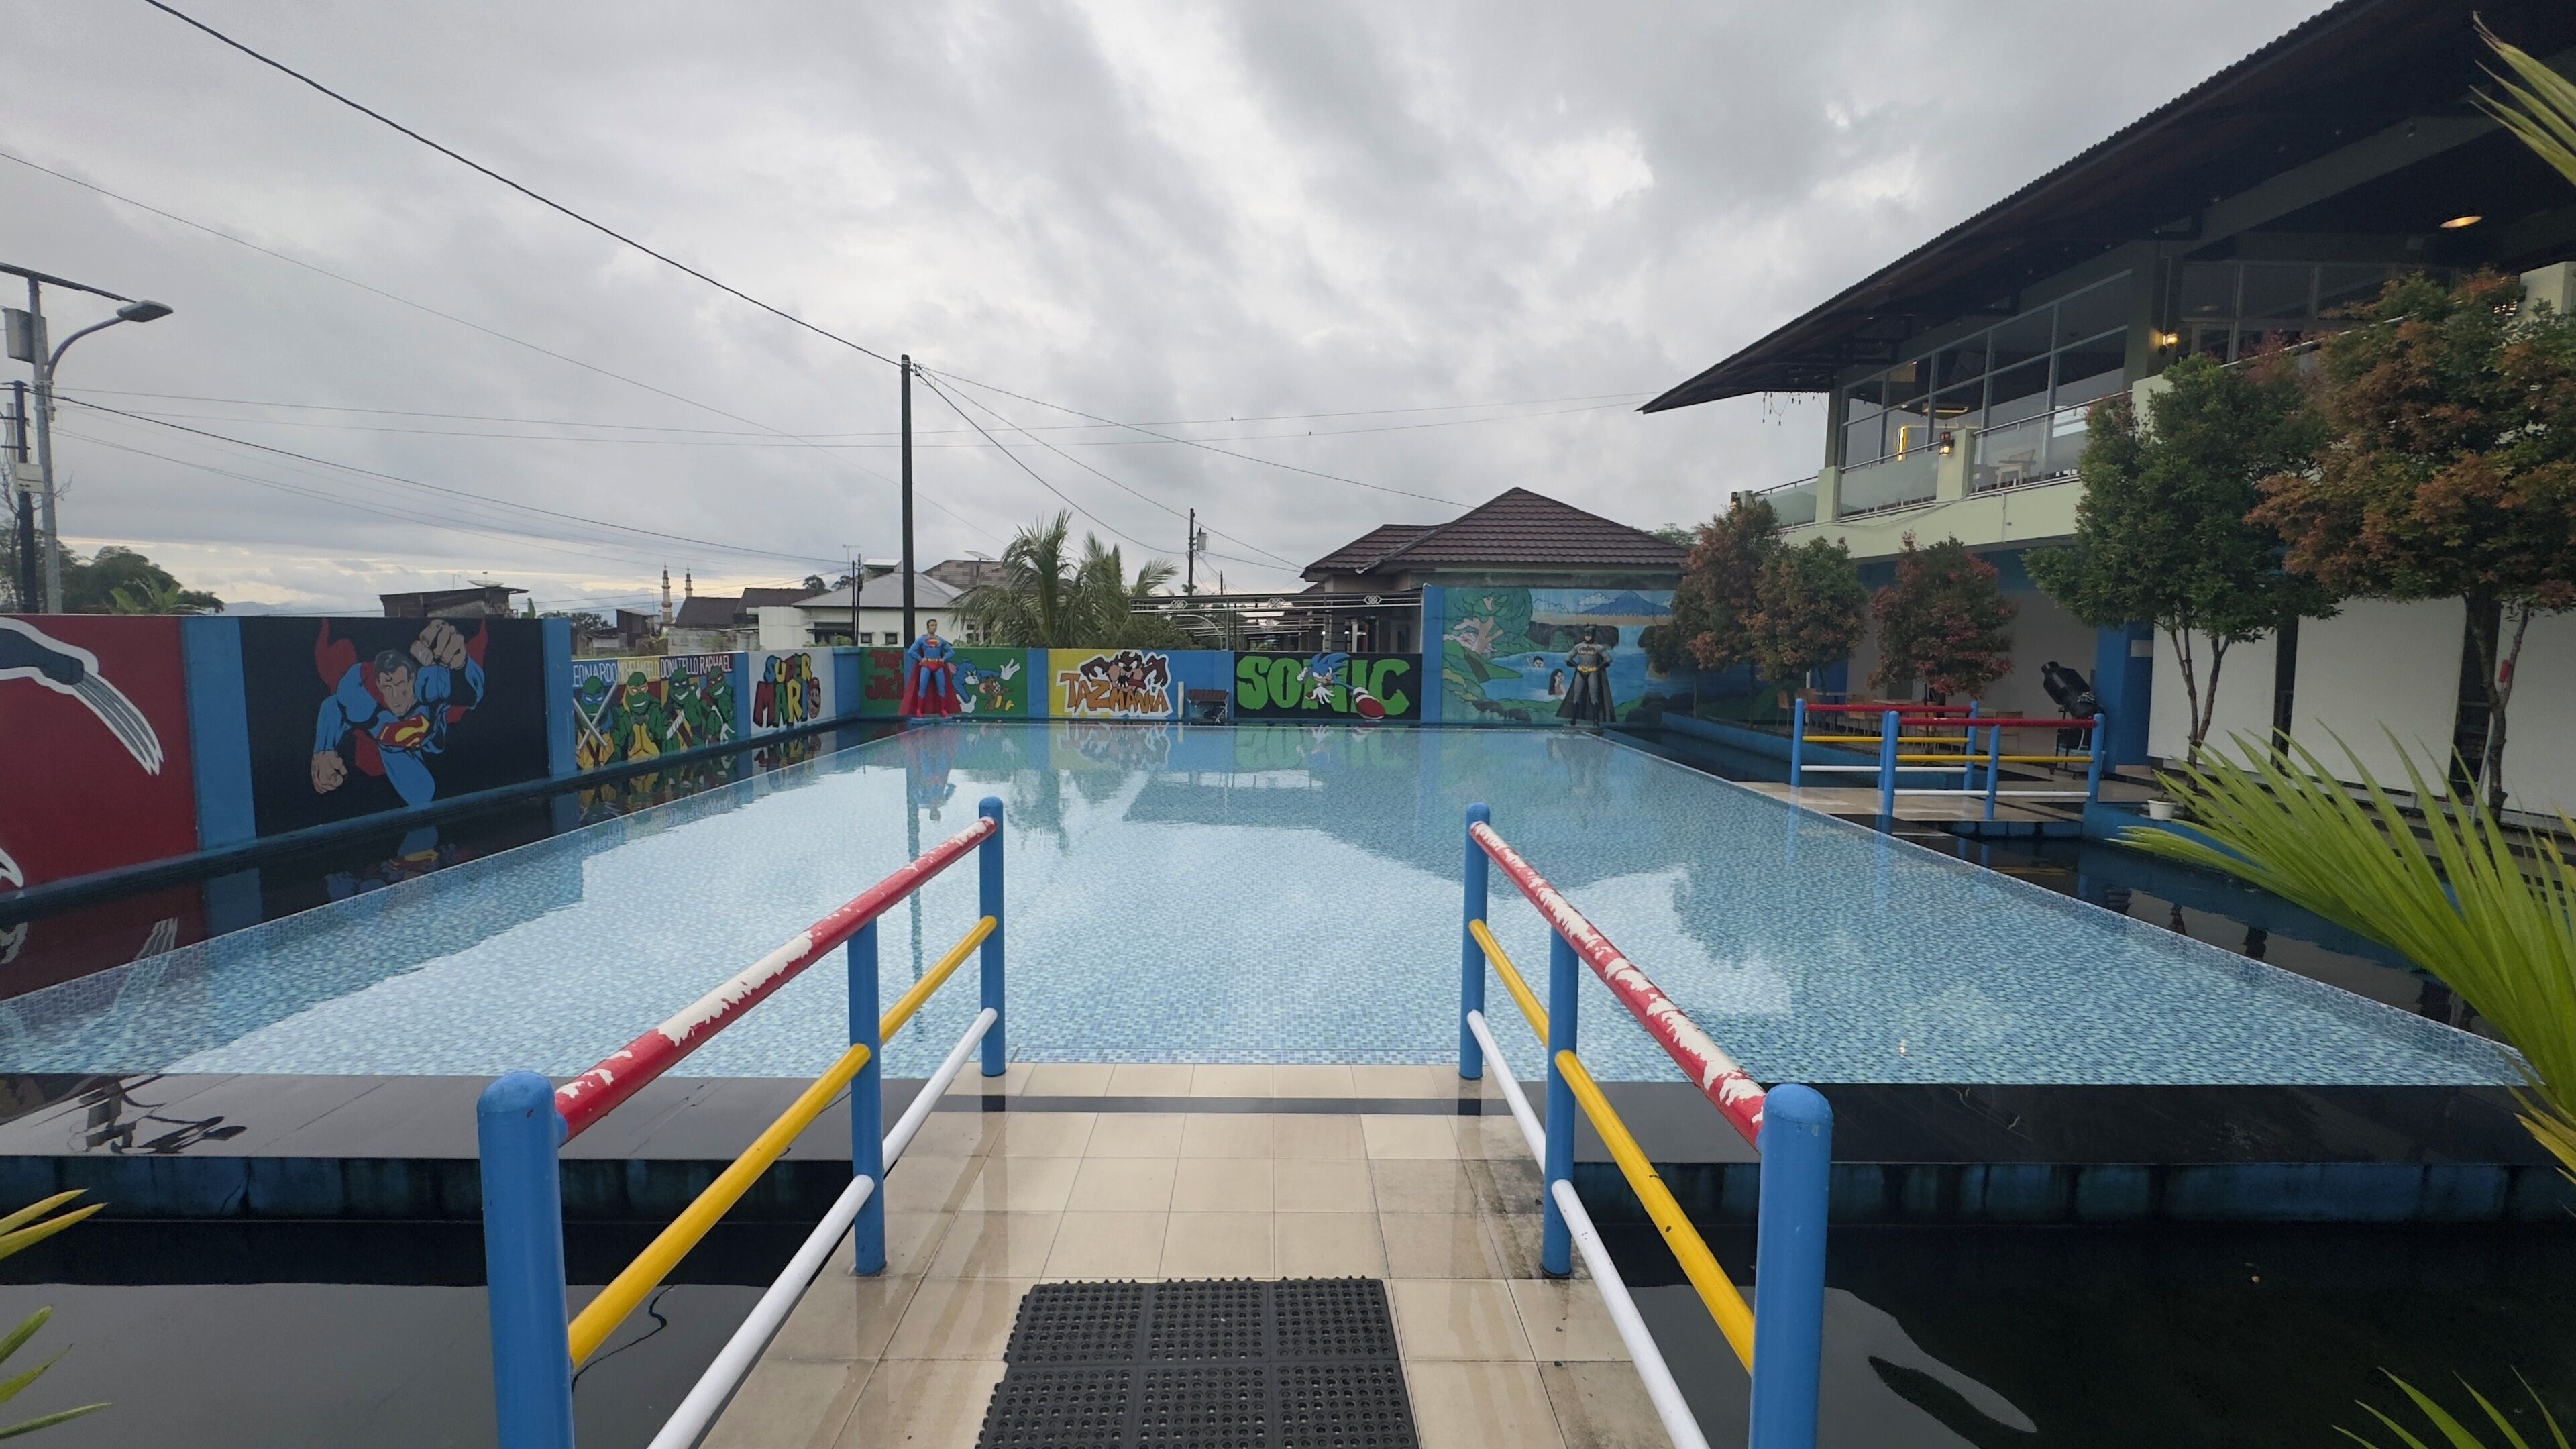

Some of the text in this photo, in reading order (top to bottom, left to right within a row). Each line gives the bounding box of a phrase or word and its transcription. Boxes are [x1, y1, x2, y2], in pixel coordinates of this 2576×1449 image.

[572, 663, 618, 688] EONARDO
[699, 655, 733, 675] RAPHAEL
[763, 653, 812, 684] SUPER
[1236, 655, 1411, 716] SONIC
[1060, 673, 1169, 714] TAZMANIA
